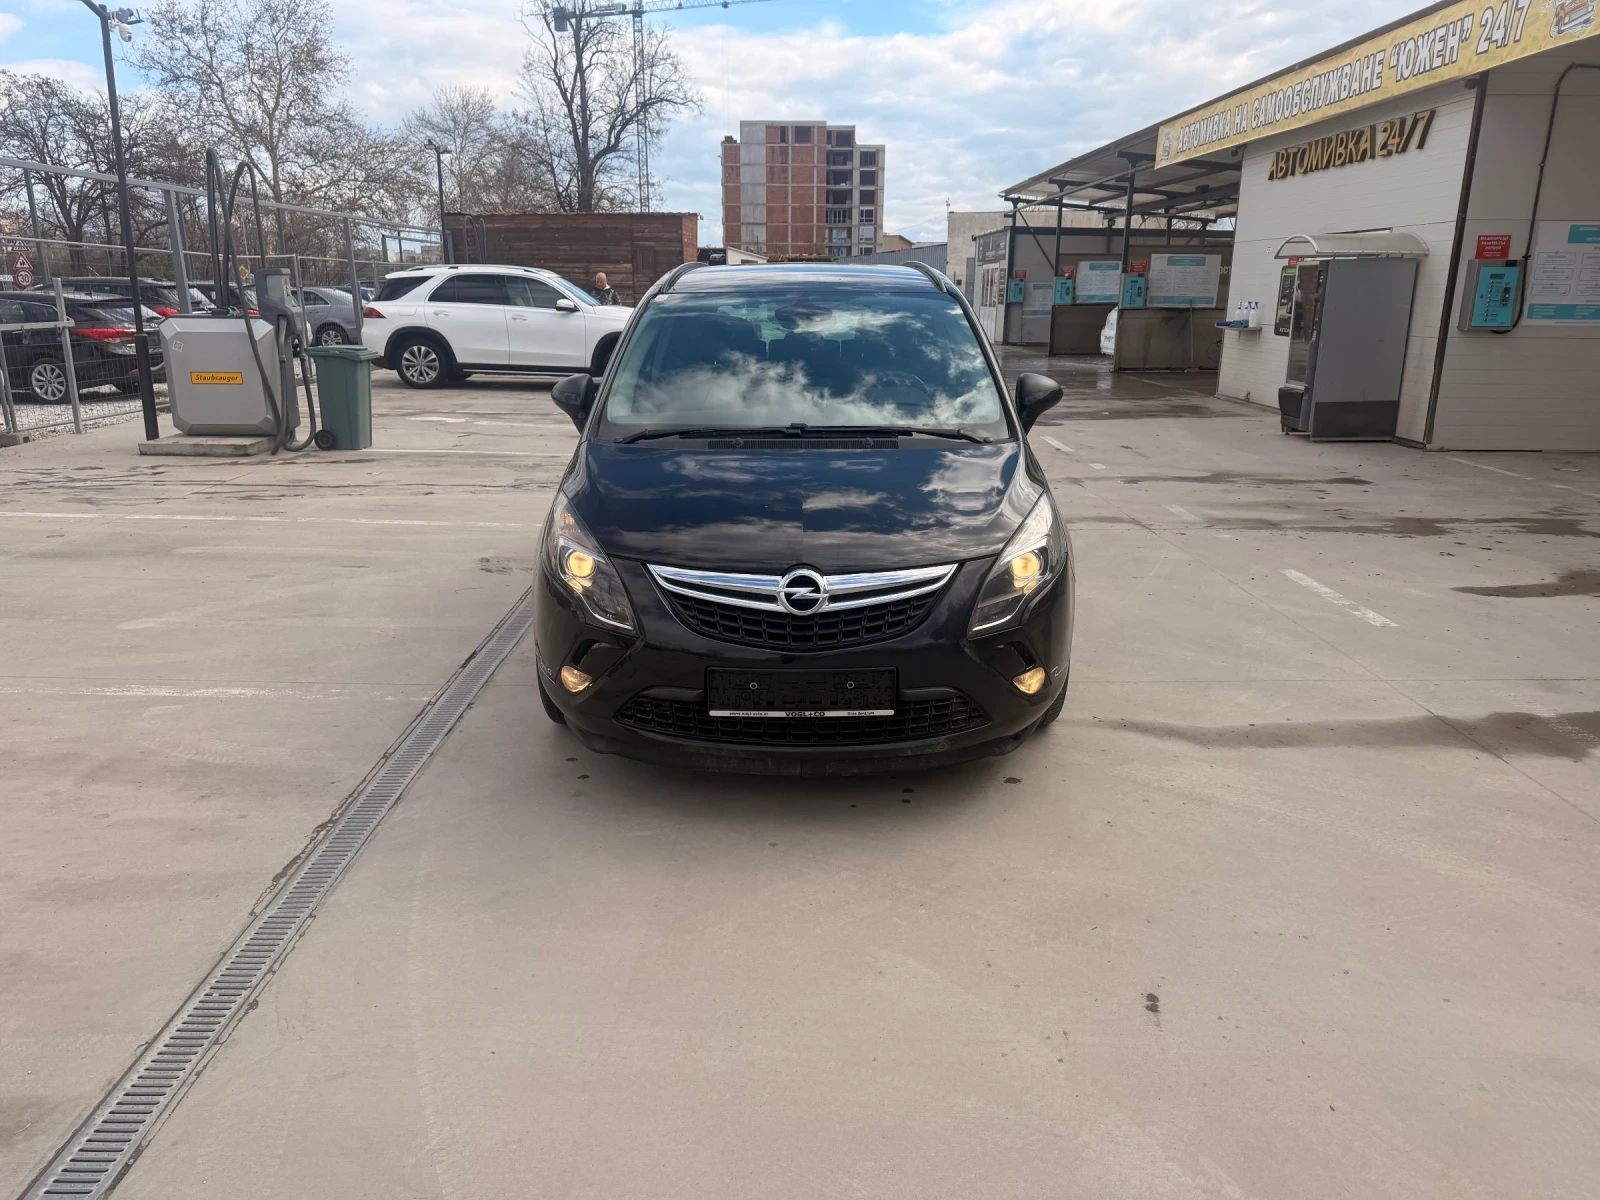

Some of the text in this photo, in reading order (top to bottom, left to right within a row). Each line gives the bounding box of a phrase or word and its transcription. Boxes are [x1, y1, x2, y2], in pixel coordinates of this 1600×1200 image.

[1177, 109, 1230, 153] АВТОМИВКА
[1233, 103, 1248, 135] НА
[1251, 49, 1385, 130] САМООБСЛУЖВАНЕ
[1476, 0, 1532, 56] 24/7
[1267, 110, 1433, 180] АВТОМИВКА 24/7
[20, 274, 29, 283] 30
[195, 374, 238, 382] Staubsauger
